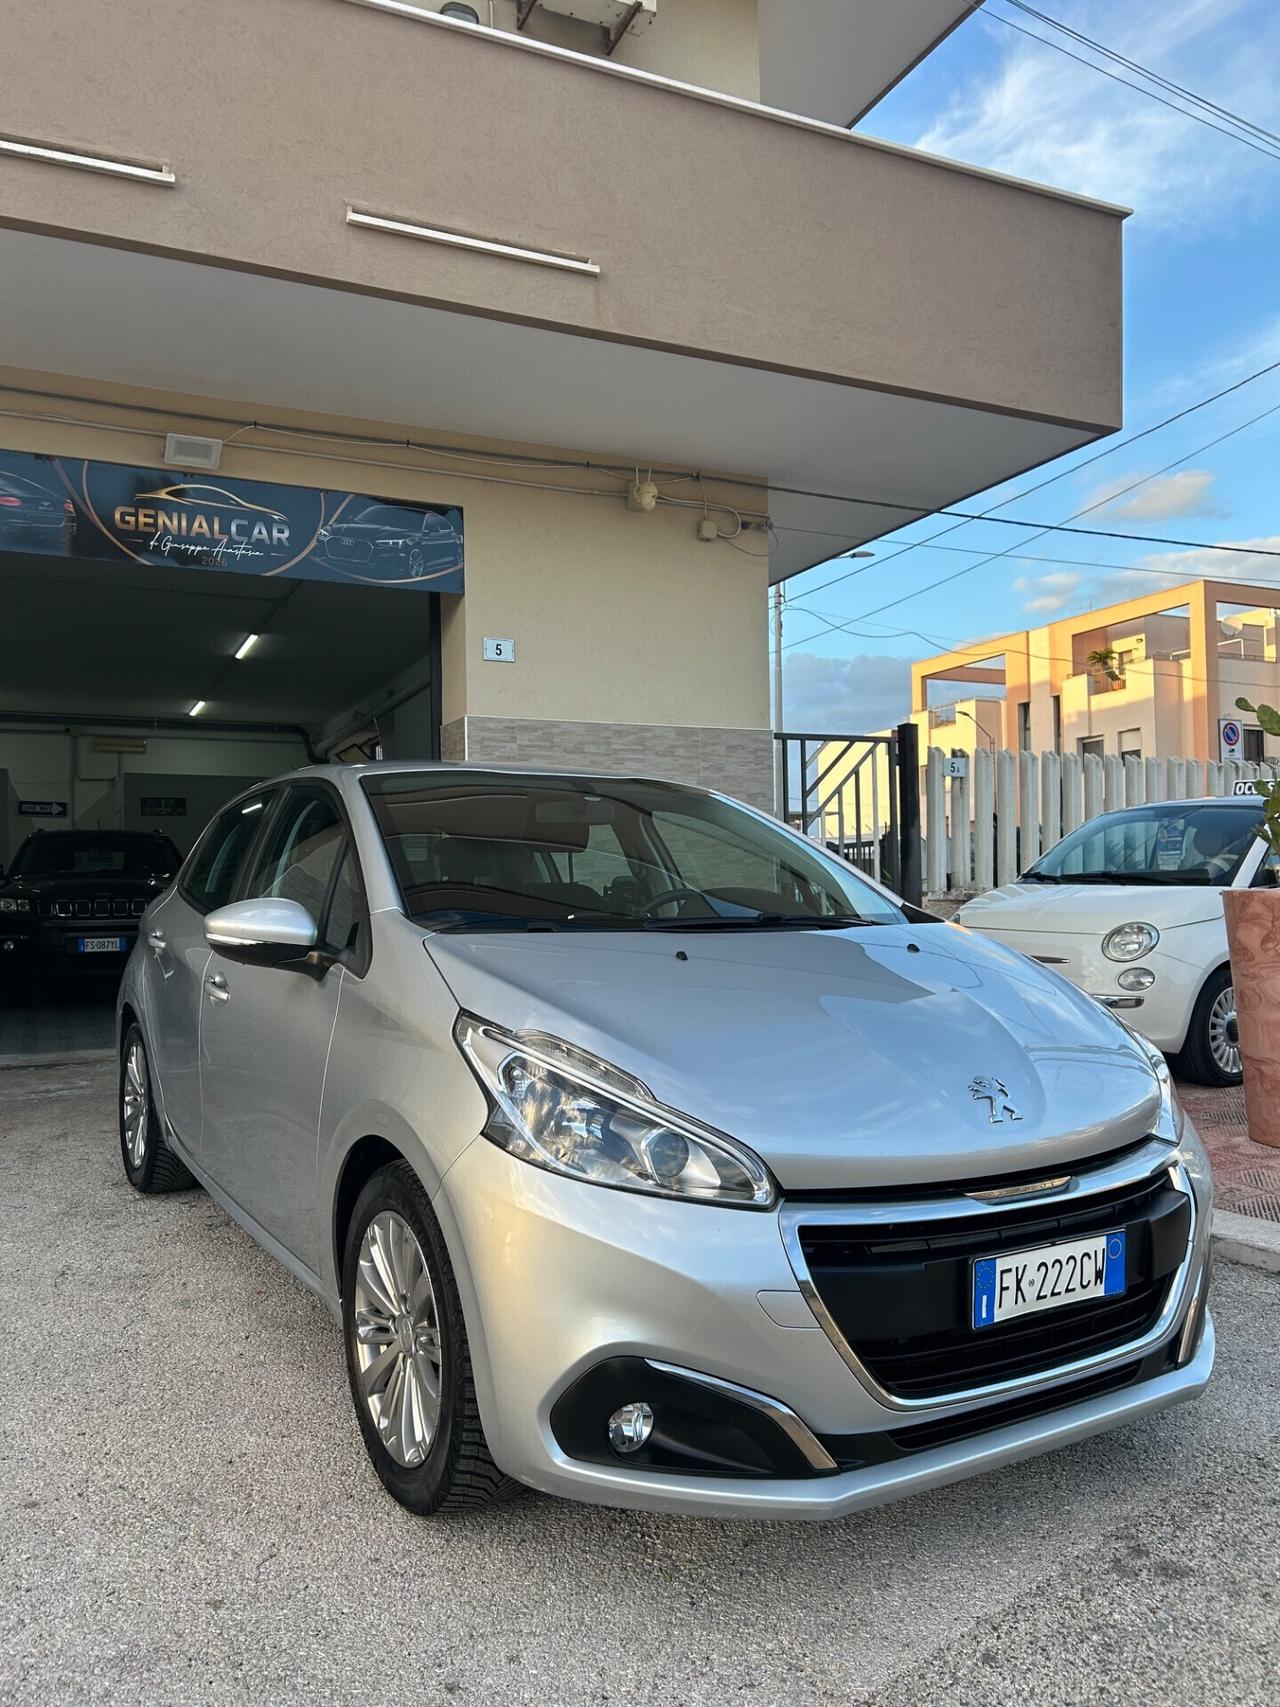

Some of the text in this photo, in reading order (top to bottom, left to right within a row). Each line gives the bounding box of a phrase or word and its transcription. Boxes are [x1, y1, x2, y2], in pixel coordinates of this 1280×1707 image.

[114, 506, 290, 547] GENIALCAR
[495, 643, 503, 656] 5
[1035, 1247, 1106, 1302] 222CW
